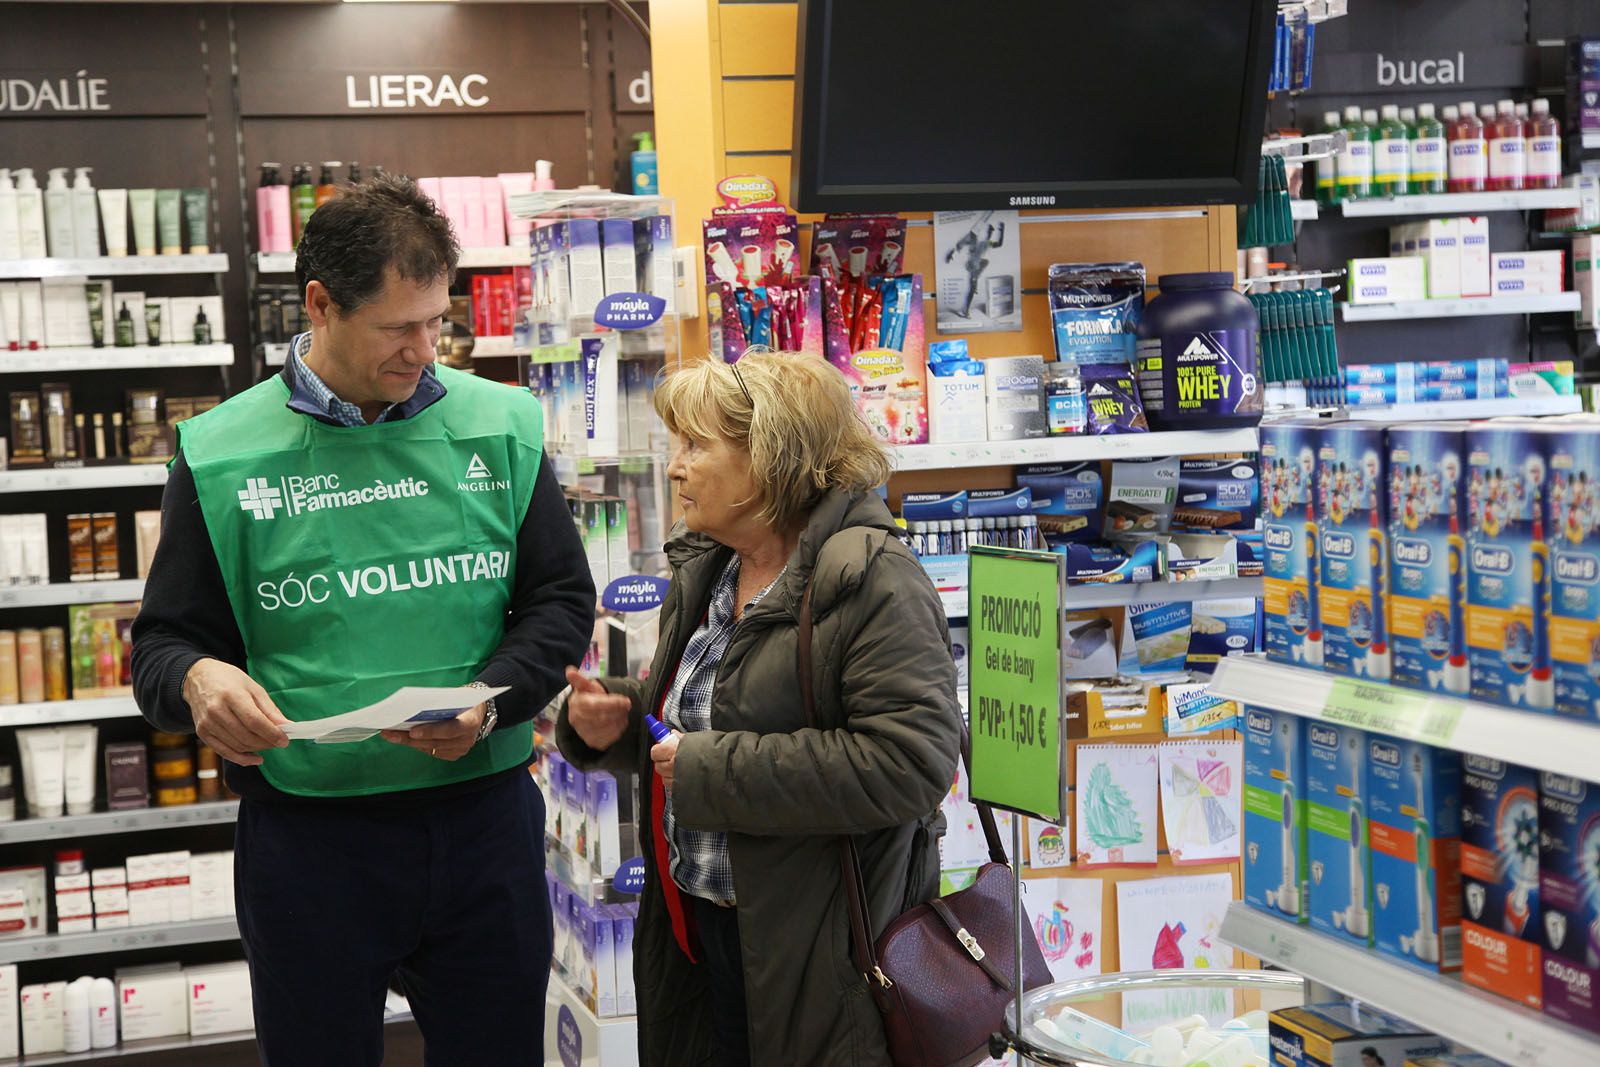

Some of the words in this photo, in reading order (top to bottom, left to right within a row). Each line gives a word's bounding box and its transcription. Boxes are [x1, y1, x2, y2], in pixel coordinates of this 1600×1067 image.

[1377, 51, 1464, 86] bucal
[346, 74, 489, 108] LIERAC
[1009, 196, 1056, 206] SAMSUNG
[1062, 295, 1112, 303] MULTIPOWER
[606, 313, 653, 321] PHARMA
[1066, 318, 1122, 336] FORMULA
[1069, 336, 1112, 345] EVOLUTION
[856, 355, 897, 365] Dinadax
[1177, 352, 1218, 362] MULTIPOWER
[1177, 367, 1194, 377] 100%
[1196, 365, 1216, 376] PURE
[1177, 374, 1231, 400] WHEY
[585, 378, 594, 430] Bonflex
[1056, 401, 1083, 409] BCAA
[1091, 402, 1124, 417] WHEY
[288, 473, 340, 495] Banc
[457, 480, 510, 492] ANGELINI
[1219, 484, 1246, 495] 50%
[293, 477, 429, 515] Farmacèutic
[1066, 488, 1092, 499] 50%
[1267, 529, 1291, 545] Oral-B
[1325, 536, 1352, 553] Oral-B
[1397, 544, 1428, 562] Oral-B
[1475, 550, 1510, 569] Oral-B
[1558, 558, 1594, 578] Oral-B
[257, 572, 330, 611] SÓC
[337, 551, 510, 598] VOLUNTARI
[614, 595, 660, 604] PHARMA
[981, 592, 1041, 639] PROMOCIÓ
[1134, 608, 1187, 629] SUSTITUTIVE
[985, 646, 1000, 670] Gel
[1001, 648, 1012, 673] de
[1014, 650, 1035, 683] bany
[979, 696, 1006, 740] PVP:
[1009, 702, 1034, 752] 1,50
[1039, 707, 1047, 748] €
[1250, 714, 1271, 731] Oral-B
[1249, 735, 1271, 747] VITALITY
[1311, 729, 1336, 745] Oral-B
[1311, 748, 1336, 762] VITALITY
[1373, 747, 1398, 764] Oral-B
[1373, 766, 1399, 780] VITALITY
[1465, 929, 1507, 955] COLOUR
[1546, 960, 1591, 987] COLOUR
[1270, 1034, 1303, 1061] waterpik
[1405, 1038, 1452, 1057] waterpik
